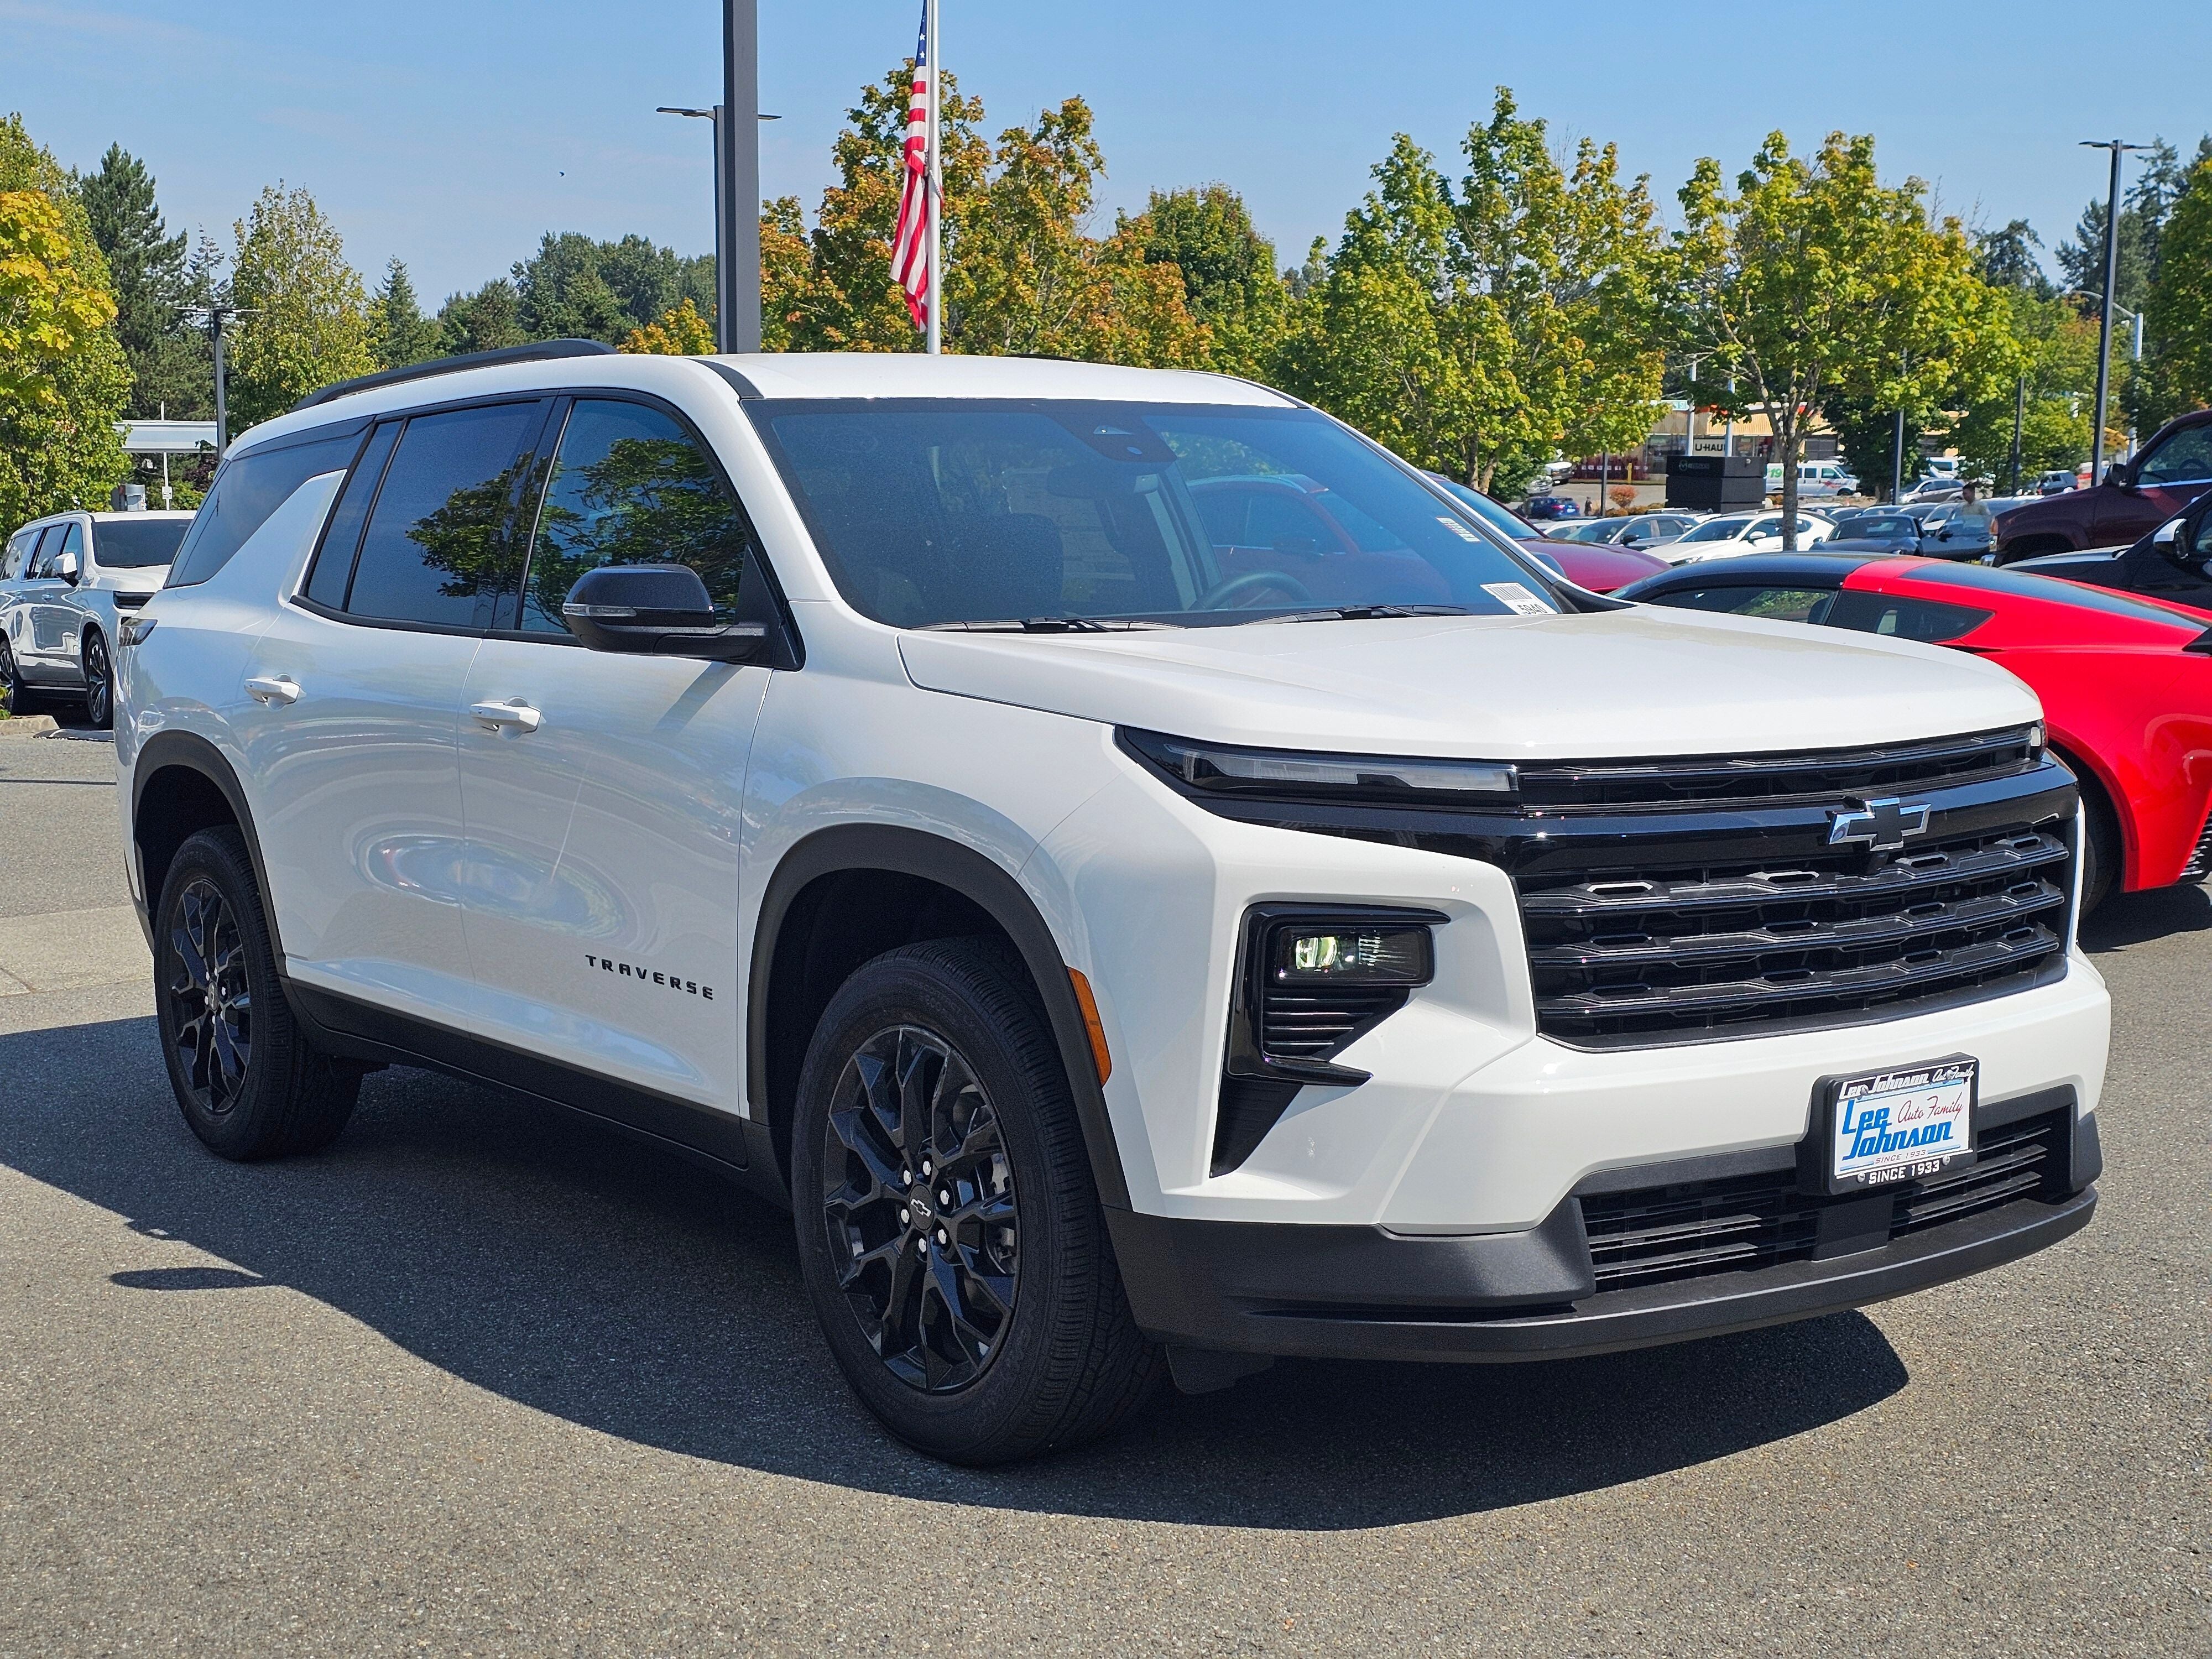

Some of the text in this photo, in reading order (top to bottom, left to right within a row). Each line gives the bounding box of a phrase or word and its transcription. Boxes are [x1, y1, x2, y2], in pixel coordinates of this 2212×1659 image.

[1695, 444, 1725, 452] U-HAU
[585, 954, 713, 1000] TRAVERSE
[1868, 1073, 1929, 1094] Johnson
[1932, 1068, 1948, 1082] Aut
[1840, 1092, 1963, 1135] Lee Auto Family
[1842, 1120, 1953, 1161] Johnson
[1875, 1149, 1926, 1164] SINCE 1933
[1869, 1160, 1940, 1185] SINCE 1933
